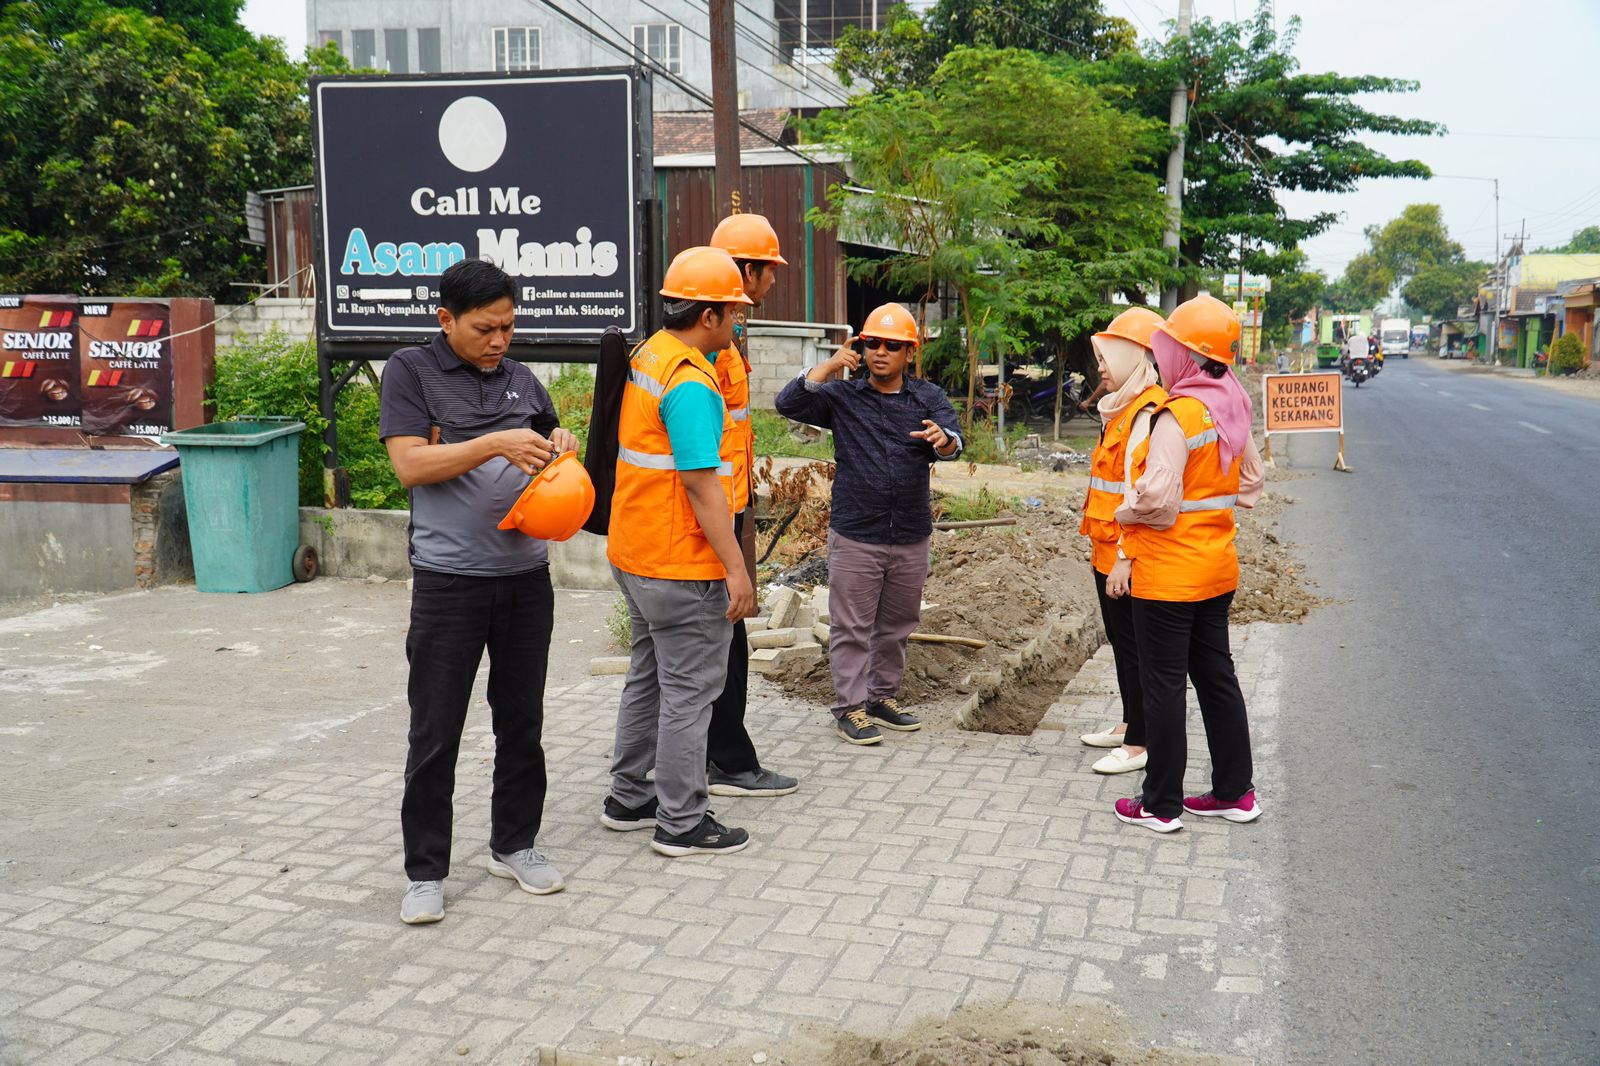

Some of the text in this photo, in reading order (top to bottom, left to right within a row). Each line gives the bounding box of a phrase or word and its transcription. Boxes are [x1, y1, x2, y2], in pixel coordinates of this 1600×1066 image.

[410, 187, 542, 216] Call Me
[340, 226, 619, 277] Asam Manis
[536, 289, 624, 299] callme asammanis
[83, 305, 108, 315] NEW
[337, 303, 349, 314] Jl.
[351, 303, 376, 316] Raya
[377, 304, 427, 316] Ngemplak
[513, 305, 554, 318] ulangan
[555, 305, 579, 316] Kab.
[580, 305, 625, 318] Sidoarjo
[2, 332, 73, 350] SENIOR
[46, 352, 70, 360] LATTE
[88, 341, 162, 359] SENIOR
[134, 361, 159, 369] LATTE
[1278, 381, 1329, 394] KURANGI
[1272, 395, 1335, 408] KECEPATAN
[1274, 409, 1334, 422] SEKARANG
